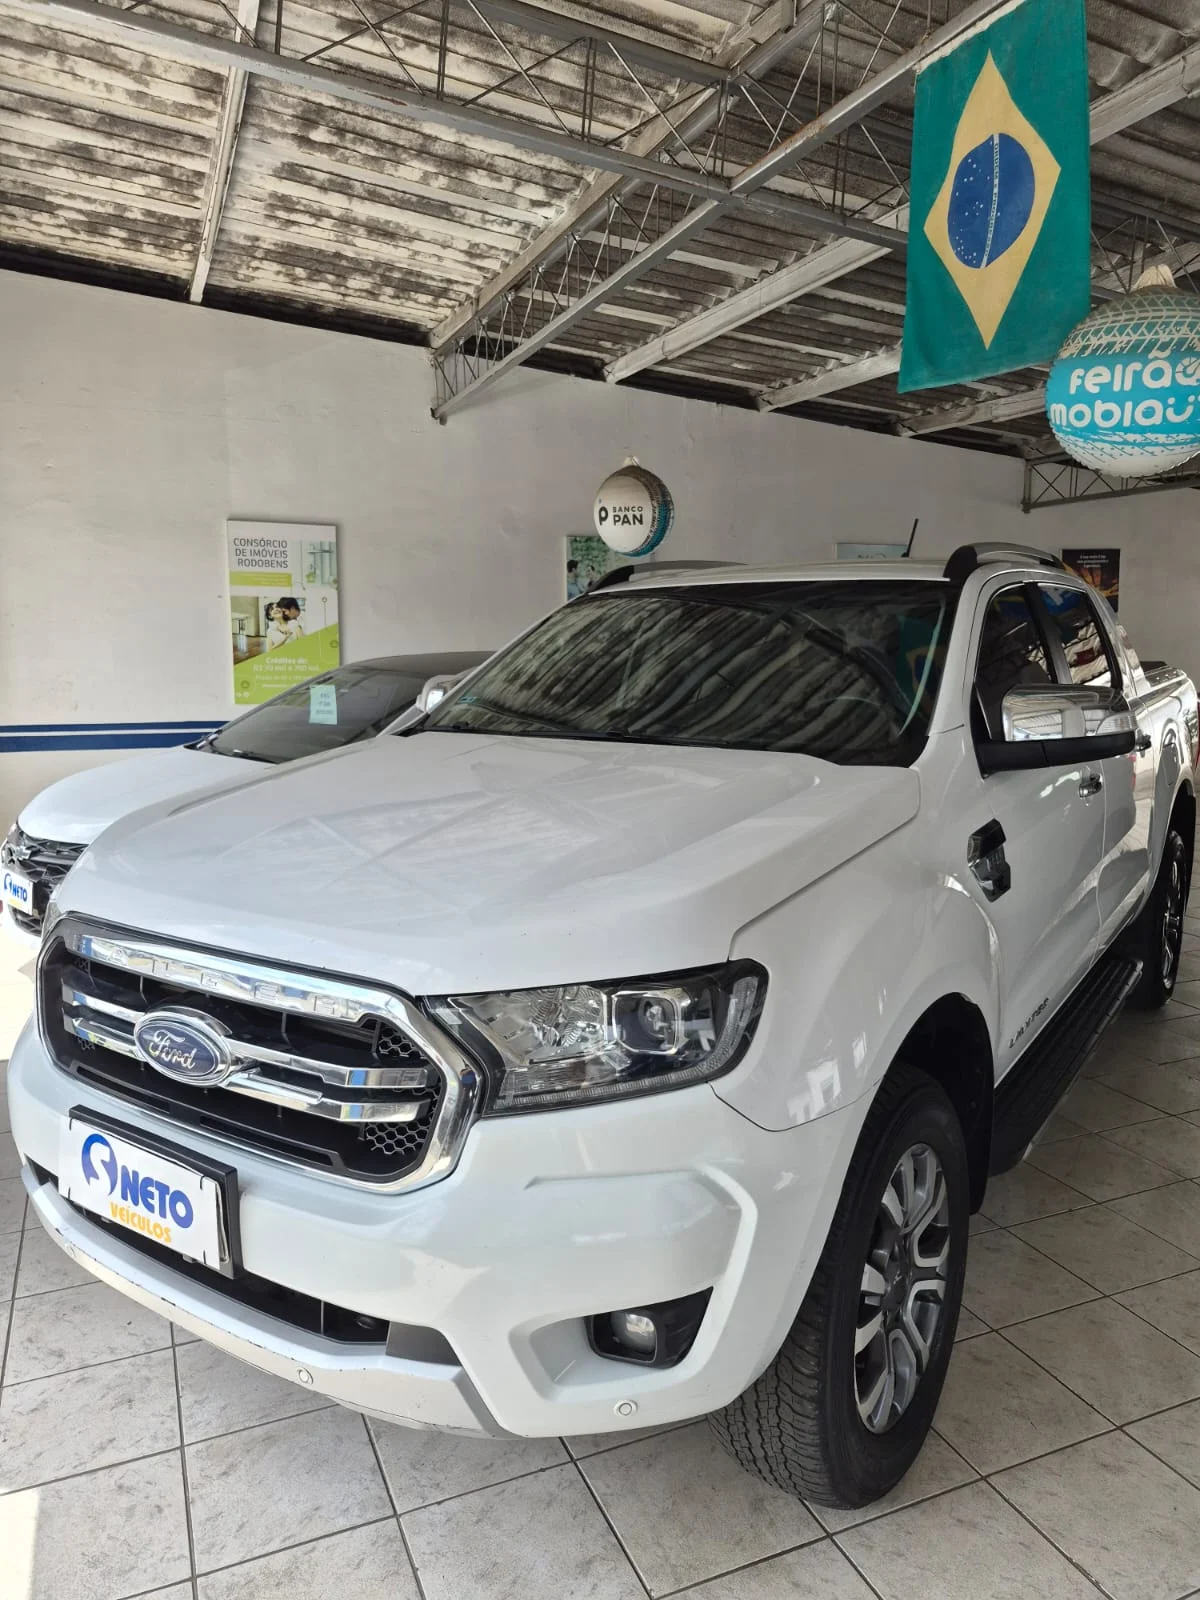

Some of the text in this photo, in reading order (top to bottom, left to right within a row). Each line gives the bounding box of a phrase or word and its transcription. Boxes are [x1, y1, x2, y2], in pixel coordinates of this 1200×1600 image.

[612, 505, 644, 514] BANCO
[613, 514, 644, 526] PAN
[233, 537, 288, 549] CONSÓRCIO
[235, 547, 288, 559] DE IMÓVEIS
[237, 558, 289, 569] RODOBENS
[12, 883, 28, 902] NETO
[148, 1029, 198, 1069] Ford
[120, 1164, 194, 1229] NETO
